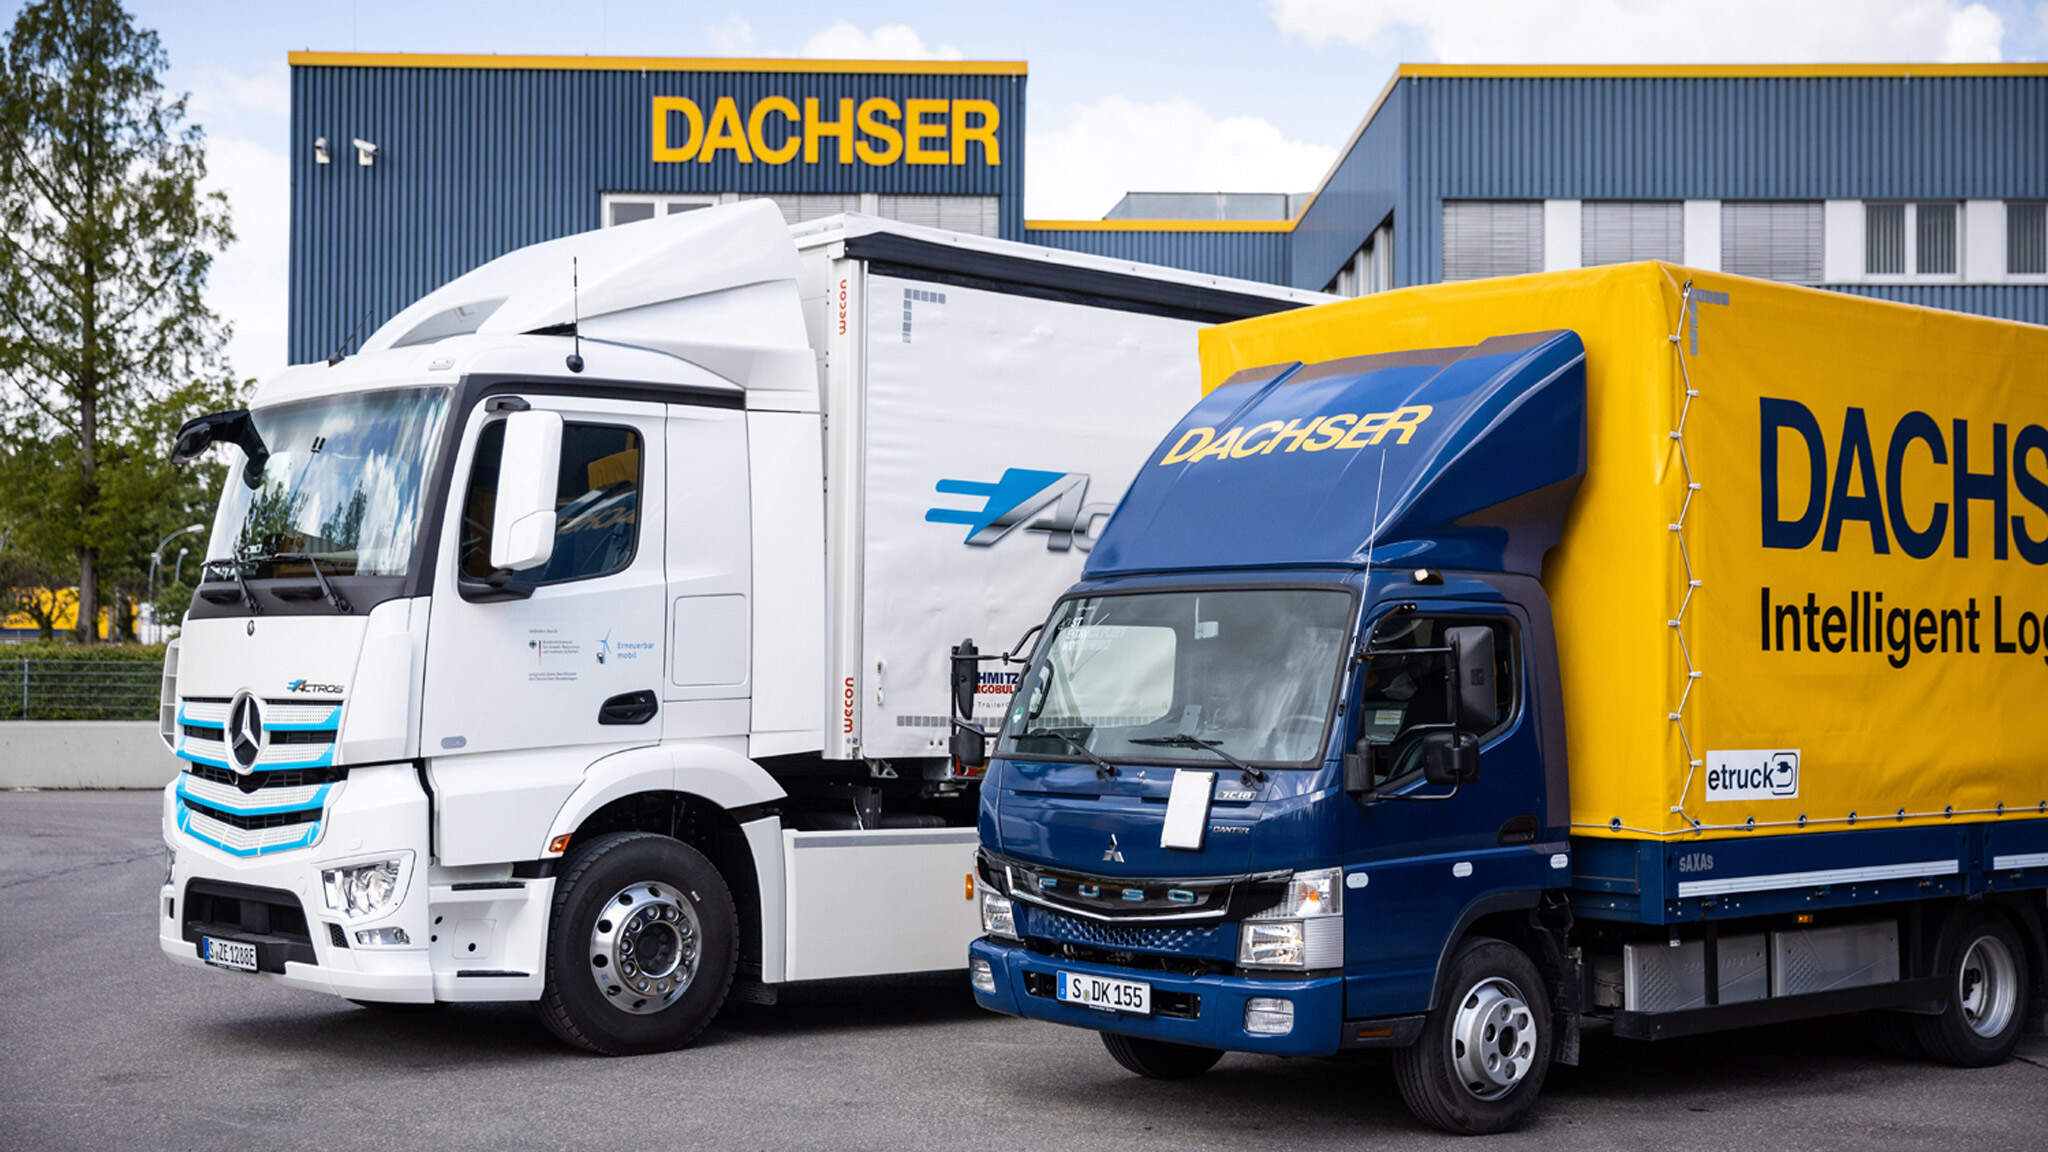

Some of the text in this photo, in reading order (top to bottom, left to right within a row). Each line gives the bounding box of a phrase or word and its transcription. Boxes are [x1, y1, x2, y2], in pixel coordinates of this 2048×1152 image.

[652, 96, 1001, 166] DACHSER
[1159, 405, 1433, 466] DACHSER
[1759, 396, 2048, 566] DACHS
[1761, 587, 2048, 669] Intelligent Lo
[844, 677, 854, 733] wecon
[1708, 761, 1774, 790] etruck
[1038, 877, 1194, 903] FUSO
[1679, 853, 1714, 872] SAXAS
[1072, 978, 1081, 998] S
[1092, 980, 1111, 1003] DK
[1114, 984, 1143, 1008] 155
